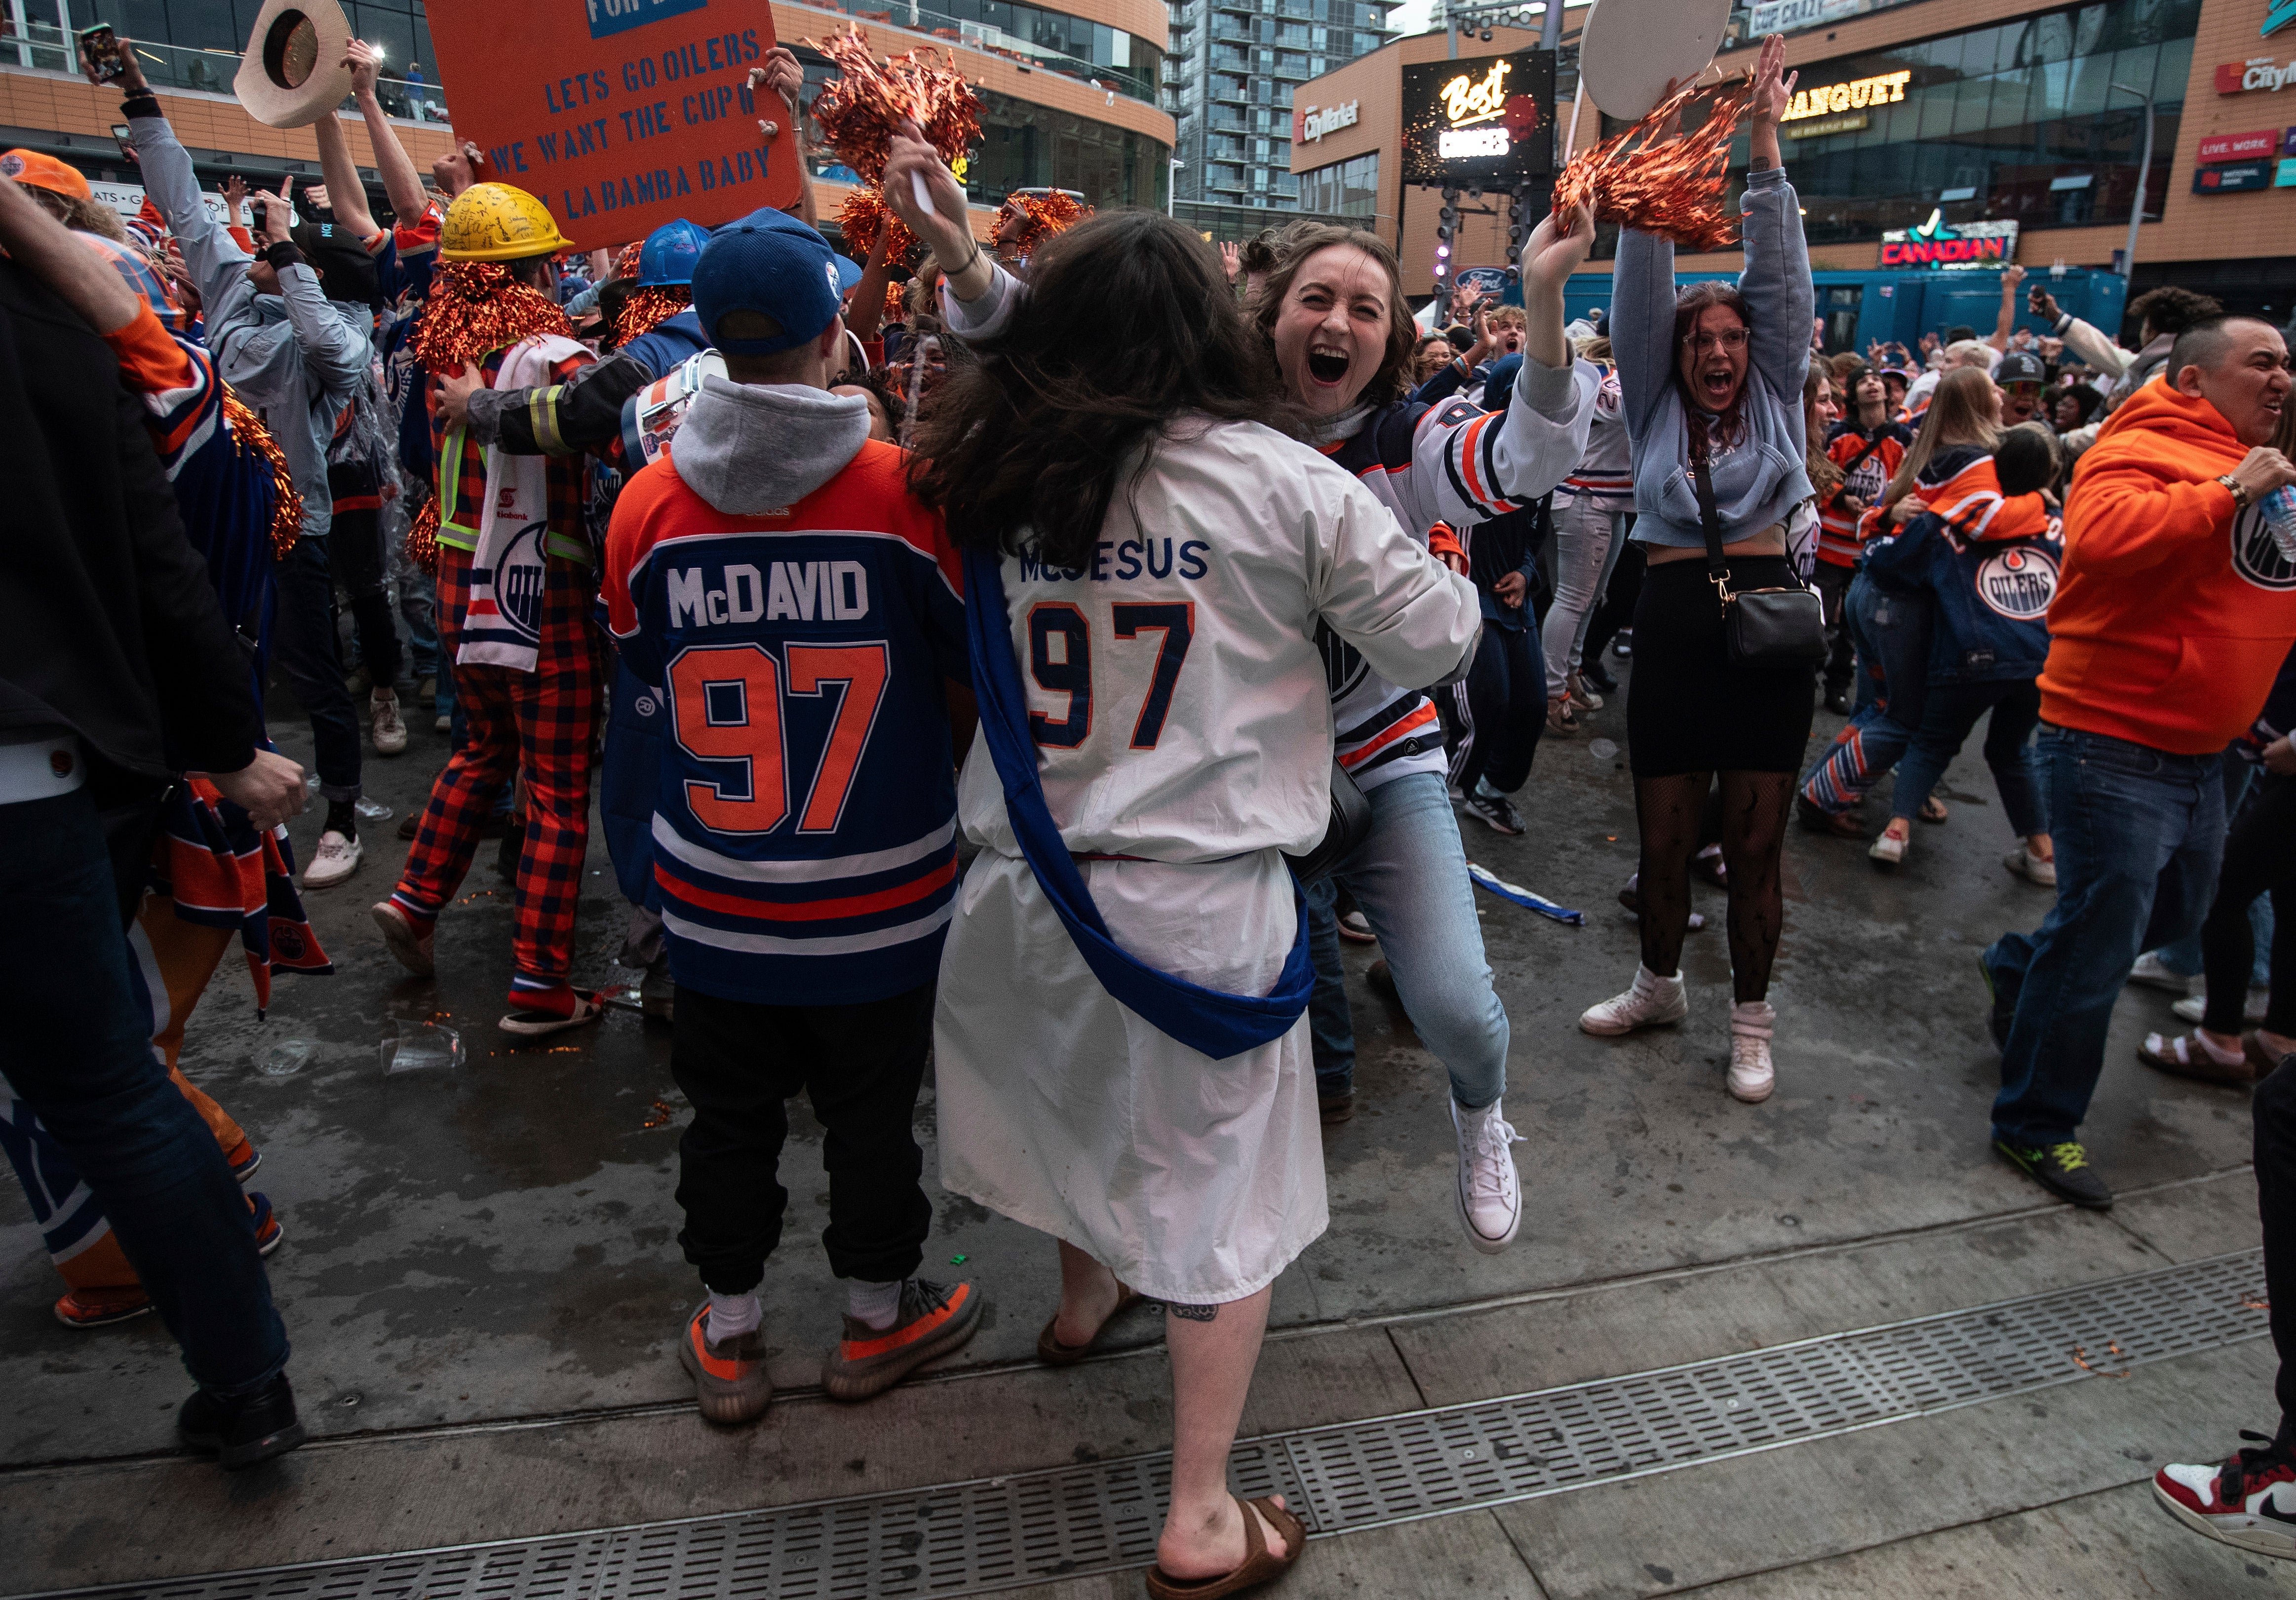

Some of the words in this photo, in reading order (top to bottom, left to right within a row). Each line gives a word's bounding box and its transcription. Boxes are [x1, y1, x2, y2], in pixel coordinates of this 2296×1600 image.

[545, 69, 609, 114] LETS
[622, 57, 656, 92] GO
[662, 28, 760, 82] OILERS
[1440, 59, 1512, 121] Best
[1780, 70, 1911, 122] ANQUET
[490, 141, 529, 176] WE
[537, 118, 608, 164] WANT
[620, 101, 671, 142] THE
[683, 85, 733, 125] CUP
[94, 191, 117, 203] ATS
[564, 186, 597, 220] LA
[601, 165, 691, 211] BAMBA
[698, 146, 770, 191] BABY
[1465, 271, 1502, 289] Frd
[1881, 237, 2004, 265] CANADIAN
[667, 561, 869, 628] McDAVID
[1989, 571, 2050, 601] OILERS
[1026, 601, 1195, 751] 97
[665, 640, 892, 836] 97
